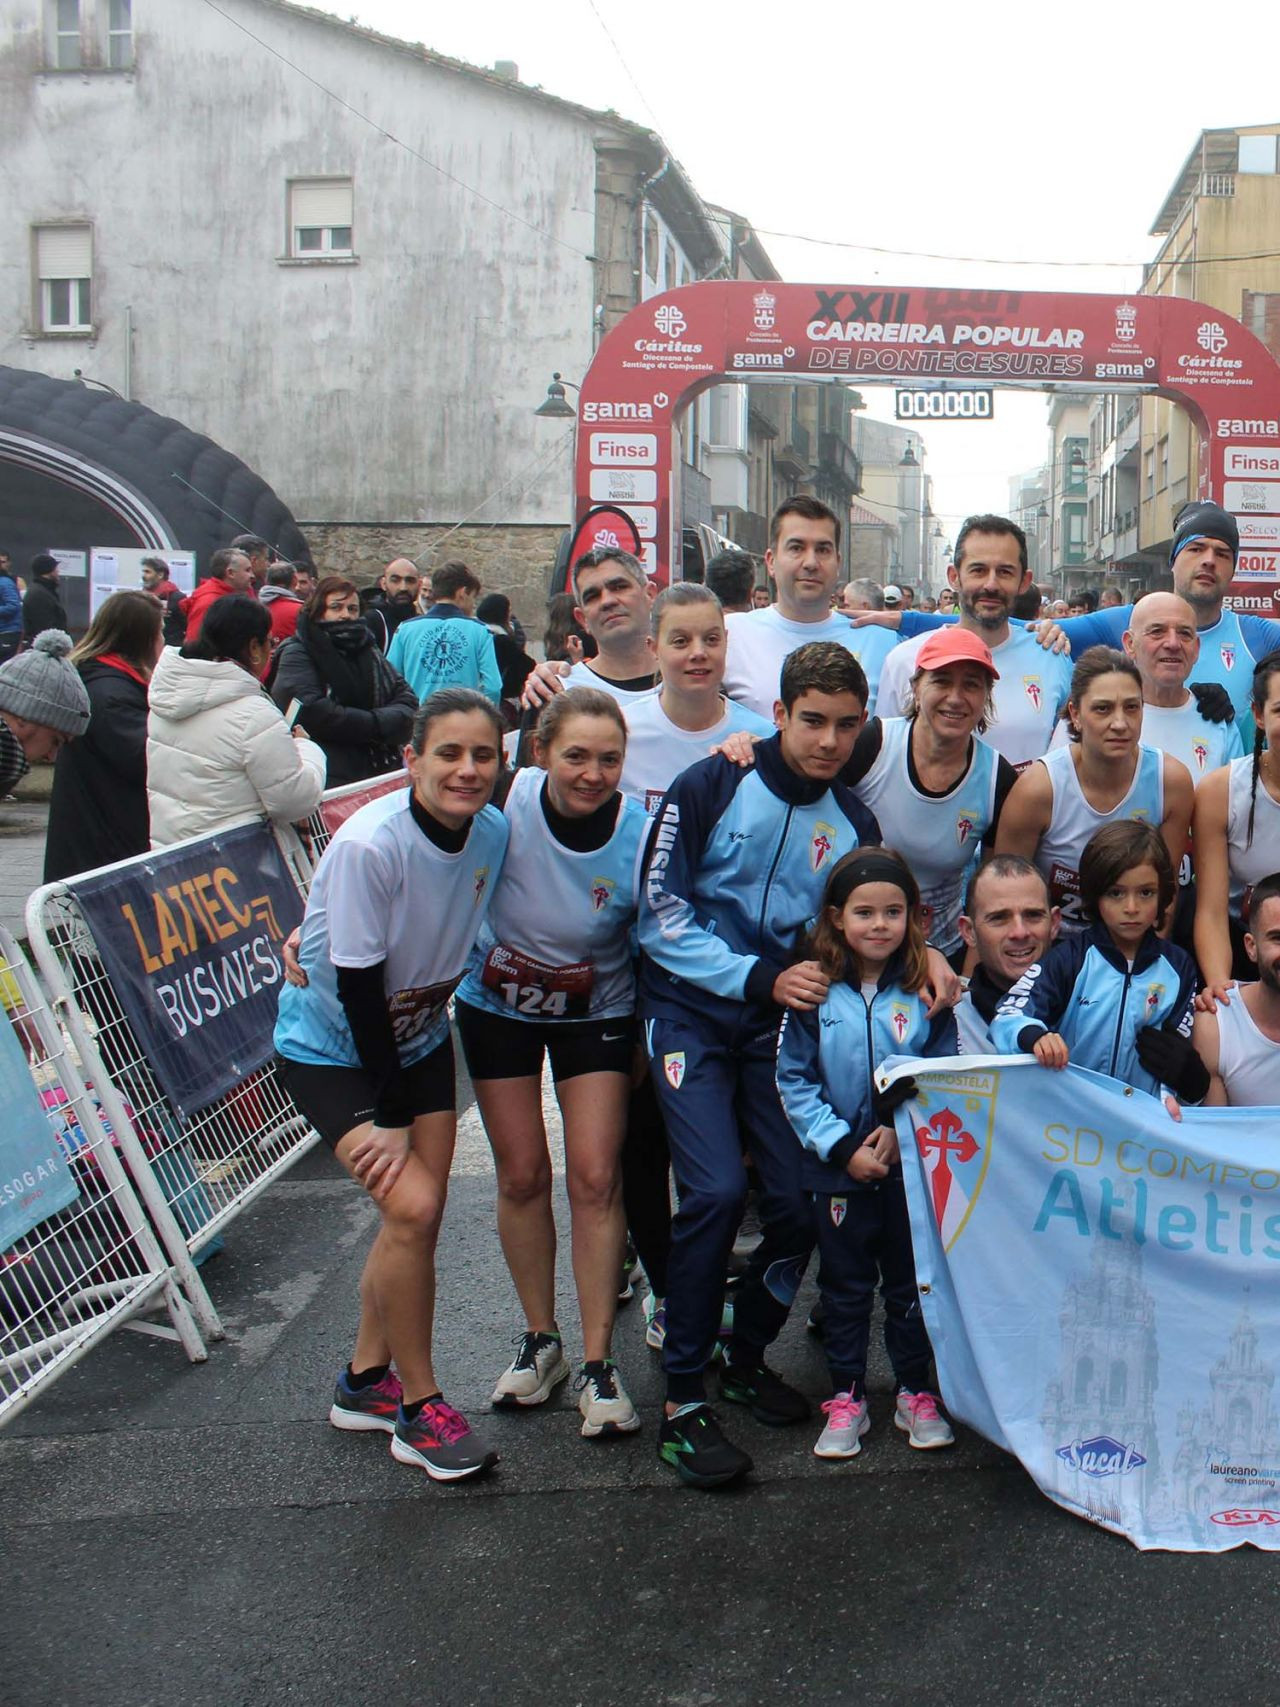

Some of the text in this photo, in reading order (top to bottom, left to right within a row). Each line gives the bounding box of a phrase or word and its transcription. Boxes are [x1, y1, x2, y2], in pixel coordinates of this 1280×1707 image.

[810, 291, 910, 322] XXII
[806, 321, 1084, 349] CARREIRA POPULAR
[635, 339, 702, 353] Cáritas
[622, 361, 655, 370] Santiago
[668, 362, 713, 372] Compostela
[733, 353, 784, 368] gama
[808, 347, 1083, 376] DE PONTECESURES
[1178, 354, 1243, 369] Cáritas
[1095, 363, 1144, 377] gama
[1224, 369, 1234, 377] de
[1166, 375, 1198, 385] Santiago
[1210, 377, 1253, 386] Compostela
[583, 402, 653, 421] gama
[1217, 419, 1279, 437] gama
[598, 441, 649, 458] Finsa
[1231, 454, 1280, 470] Finsa
[1238, 556, 1277, 571] ROIZ
[1222, 595, 1273, 611] gama
[489, 960, 518, 975] them
[500, 982, 568, 1016] 124
[917, 1072, 990, 1089] OMPOSTELA
[1042, 1123, 1103, 1167] SD
[1064, 1438, 1137, 1474] Sucal
[1224, 1477, 1276, 1488] screen printing
